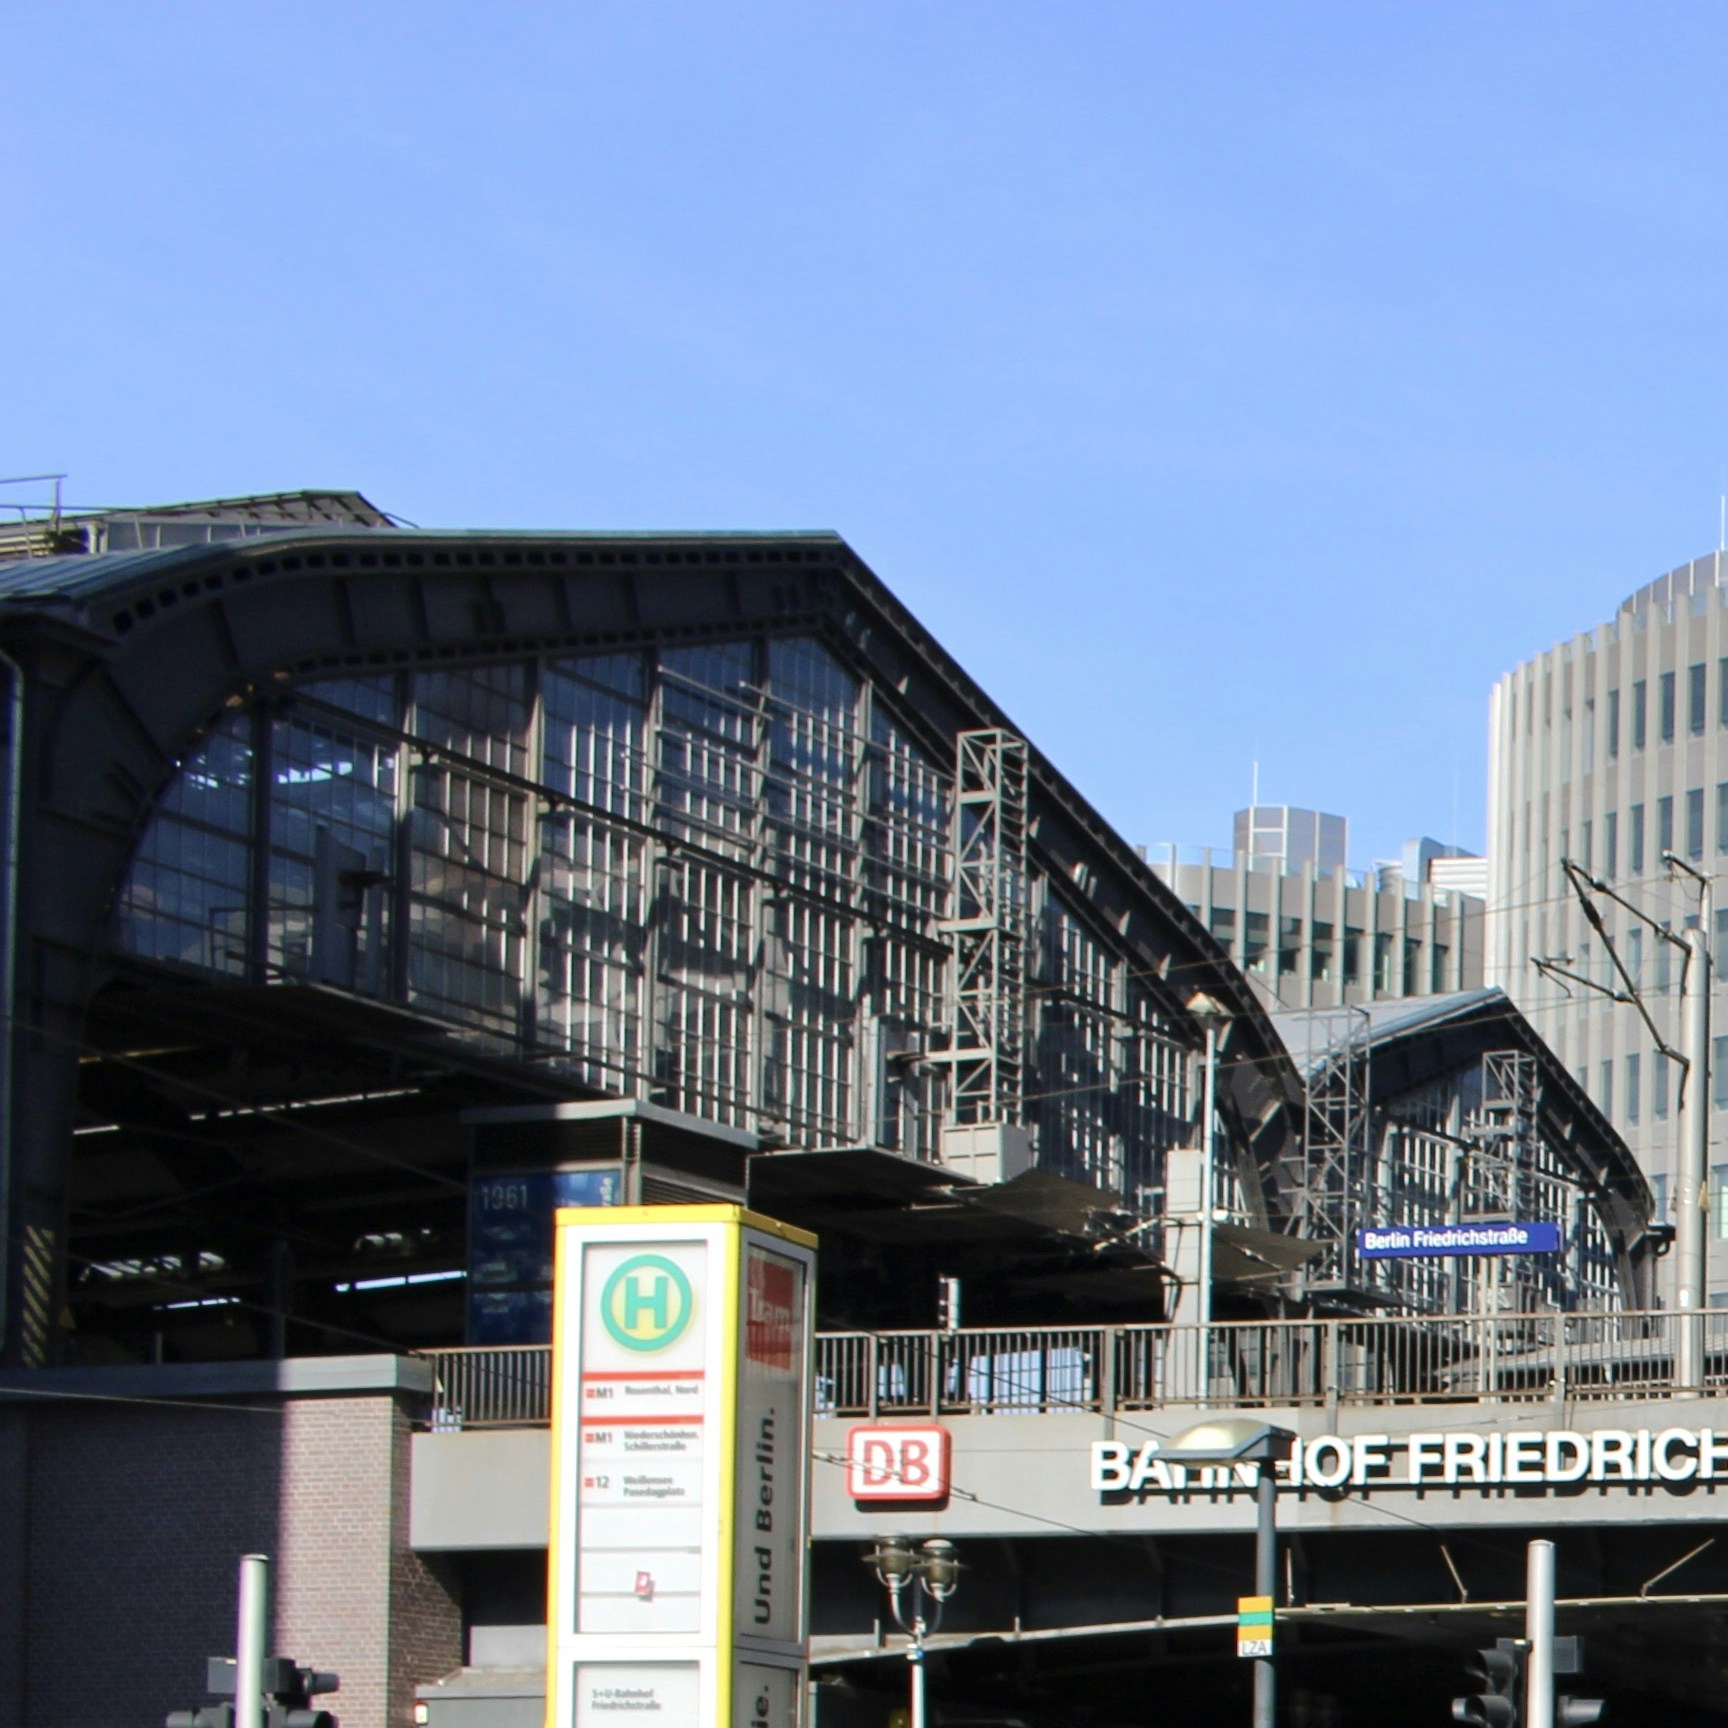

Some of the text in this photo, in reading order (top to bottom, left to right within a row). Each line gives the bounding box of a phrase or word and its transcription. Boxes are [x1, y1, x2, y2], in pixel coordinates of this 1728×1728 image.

[1365, 1227, 1529, 1249] Berlin Friedrichstraße
[623, 1275, 668, 1330] H
[748, 1287, 790, 1332] Tram
[595, 1387, 613, 1398] M1
[595, 1432, 612, 1443] M1
[862, 1440, 930, 1485] DB
[595, 1476, 609, 1488] 12
[754, 1407, 775, 1626] Und Berlin.
[1242, 1641, 1268, 1656] LZA
